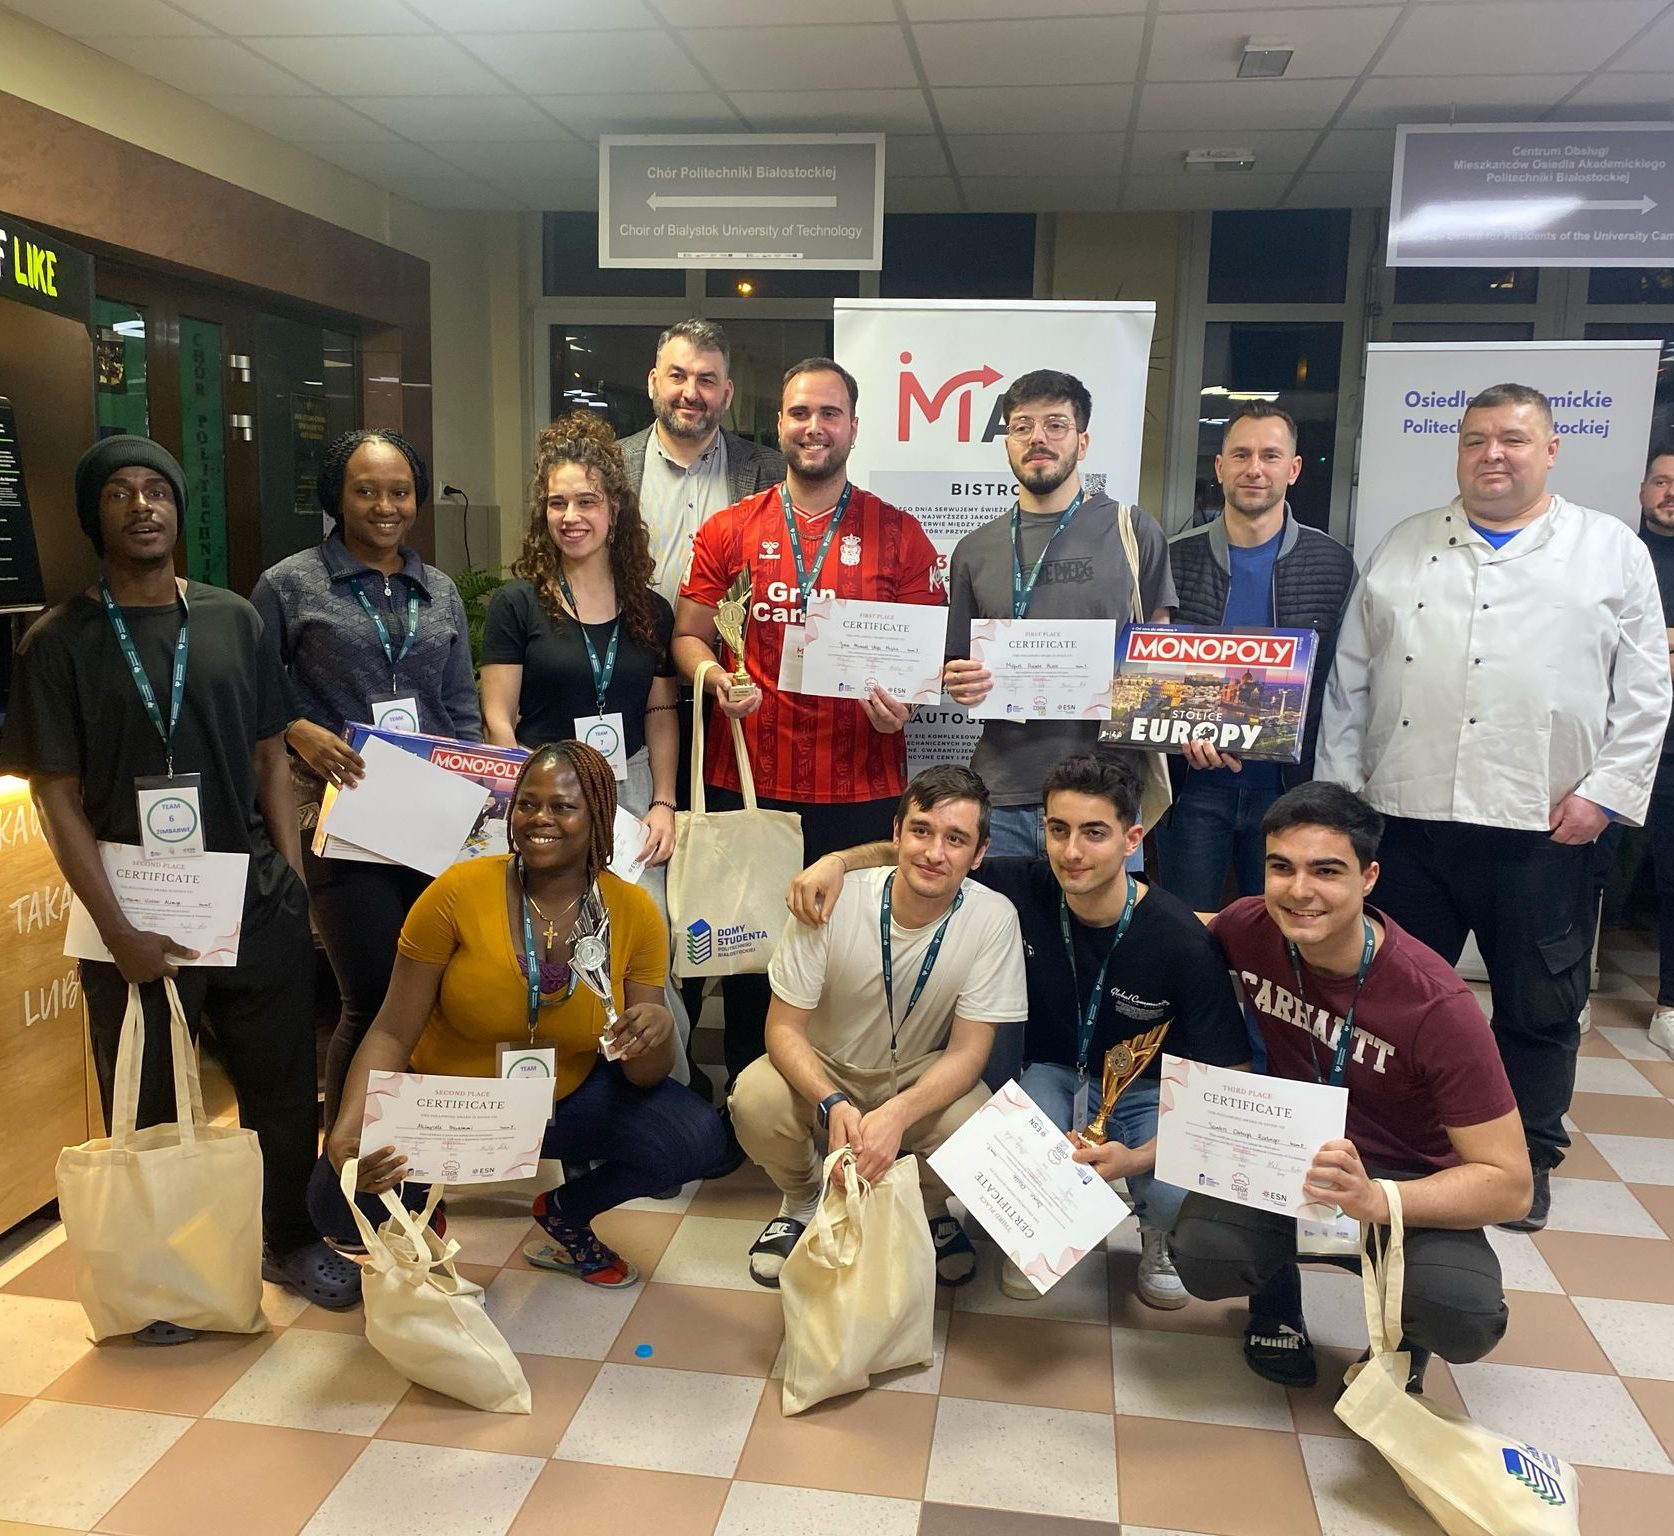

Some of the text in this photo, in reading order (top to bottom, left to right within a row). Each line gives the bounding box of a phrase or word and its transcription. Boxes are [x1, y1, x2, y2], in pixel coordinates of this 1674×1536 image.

[1512, 146, 1561, 156] Centrum
[647, 165, 677, 179] Chór
[680, 165, 753, 179] Politechniki
[1532, 159, 1575, 169] Osiedla
[1577, 158, 1667, 171] Akademickiego
[1487, 172, 1553, 183] Politechniki
[619, 223, 863, 239] Choir of Bialystok University of Technology
[1503, 230, 1557, 240] Residents
[1560, 230, 1571, 240] of
[1573, 231, 1590, 241] the
[1593, 231, 1649, 243] University
[13, 235, 58, 298] LIKE
[1547, 390, 1613, 408] mickie
[767, 581, 836, 603] Grn
[842, 620, 911, 634] CERTIFICATE
[1008, 640, 1078, 649] CERTIFICATE
[1133, 636, 1291, 664] MONOPOLY
[1172, 709, 1223, 722] STOLICE
[1131, 717, 1263, 750] EUROPY
[434, 752, 521, 778] MONOPOLY
[163, 862, 185, 870] PLACE
[116, 868, 201, 884] CERTIFICATE
[717, 924, 746, 937] DOMY
[717, 930, 768, 946] STUDENTA
[434, 1088, 491, 1098] SECOND PLACE
[1223, 1084, 1273, 1099] THIRD PLACE
[416, 1098, 506, 1110] CERTIFICATE
[1203, 1091, 1293, 1119] CERTIFICATE
[1028, 1117, 1043, 1133] ESN
[1270, 1192, 1288, 1202] ESN
[973, 1170, 1036, 1240] CERTIFICATE
[1250, 1334, 1300, 1350] PUMA
